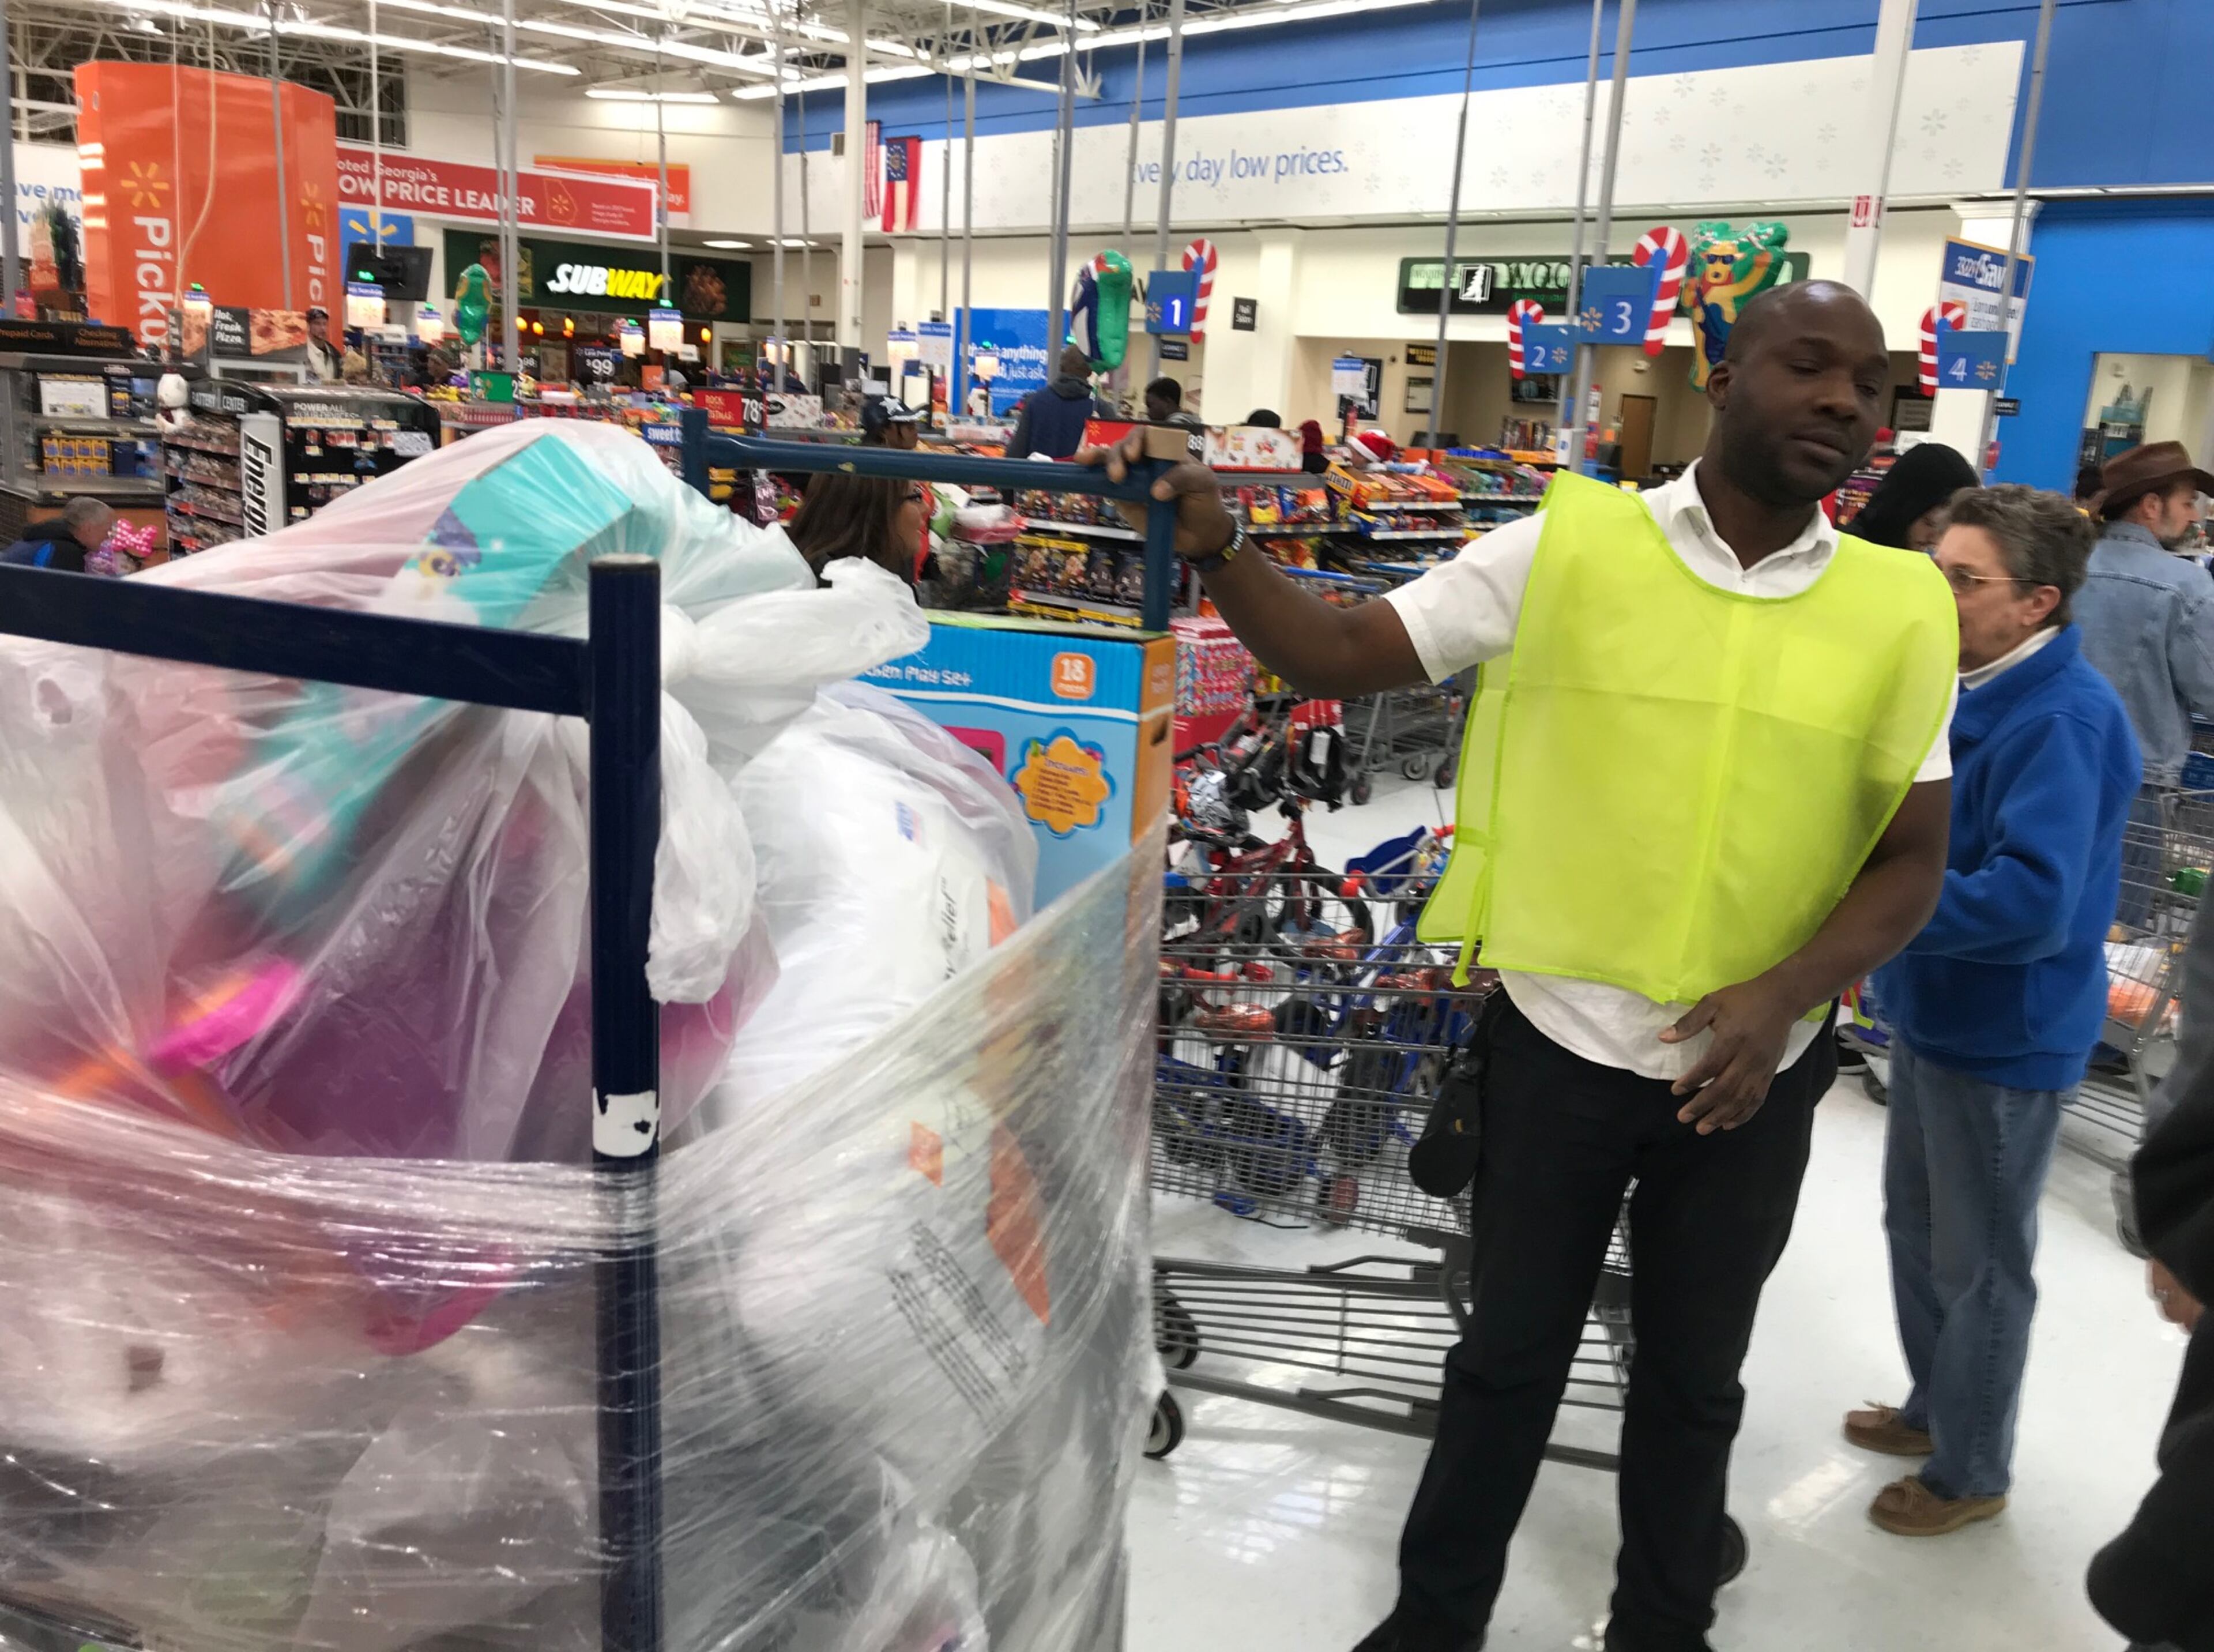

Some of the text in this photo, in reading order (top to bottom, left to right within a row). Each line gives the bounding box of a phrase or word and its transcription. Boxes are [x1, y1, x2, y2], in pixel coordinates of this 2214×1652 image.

[337, 159, 370, 173] oted
[1185, 151, 1225, 187] day
[1230, 149, 1270, 179] low
[1274, 145, 1349, 184] prices.
[338, 174, 377, 196] OW
[385, 180, 449, 206] PRICE
[133, 216, 175, 348] Picku
[547, 263, 673, 300] SUBWAY
[1171, 299, 1181, 327] 1
[1612, 301, 1632, 334] 3
[30, 329, 55, 339] Cards
[1531, 345, 1546, 367] 2
[1948, 357, 1968, 382] 4
[222, 396, 246, 411] CENTER
[293, 402, 328, 411] POWER
[905, 666, 940, 684] Play
[942, 669, 973, 687] Set
[1060, 657, 1086, 682] 18
